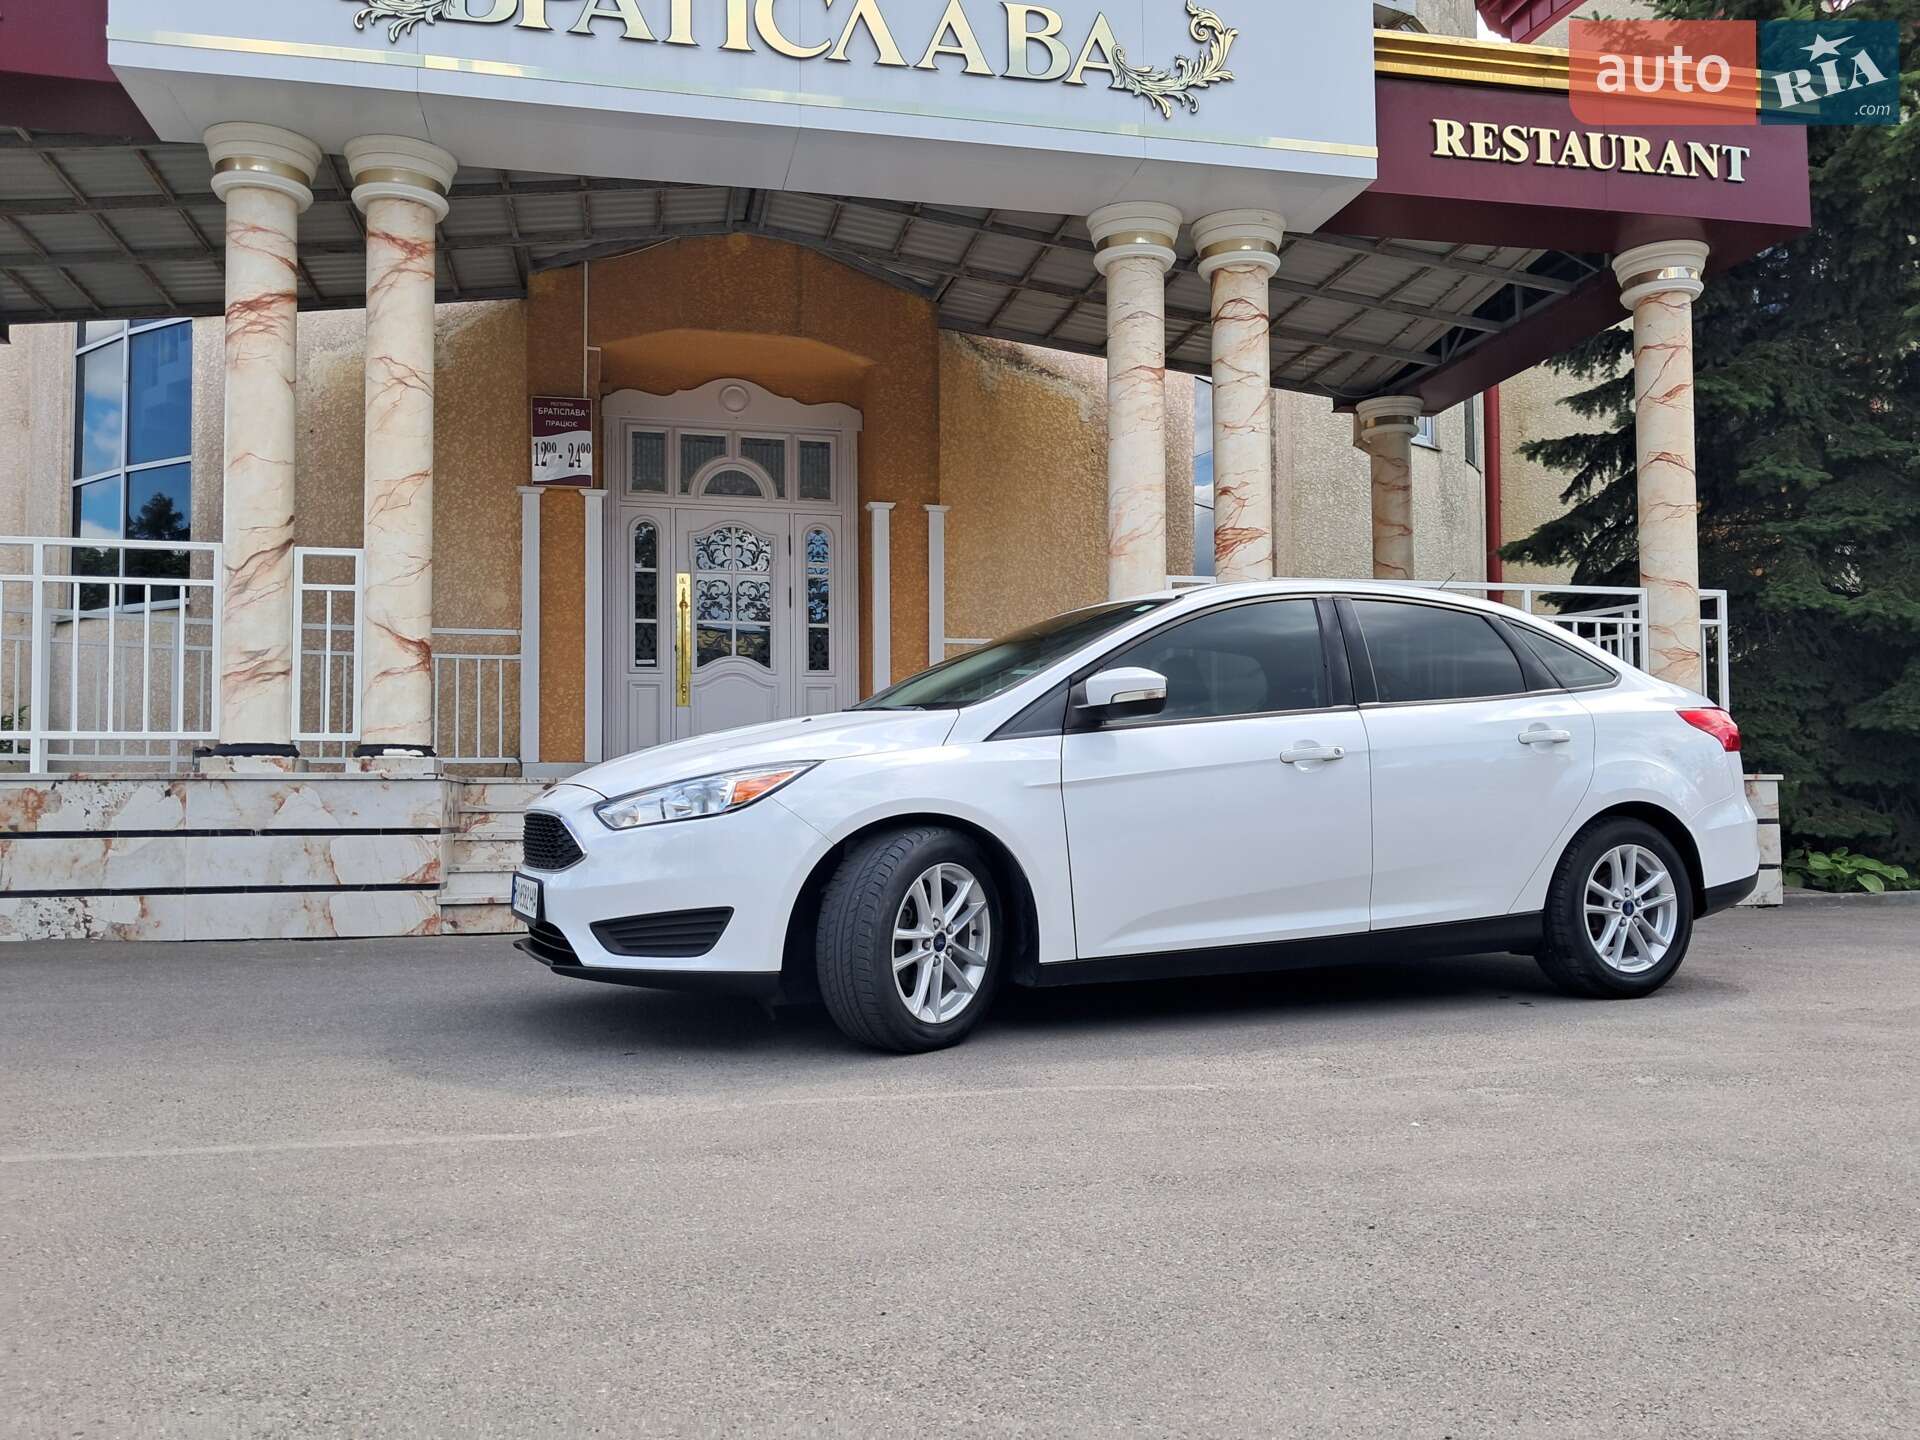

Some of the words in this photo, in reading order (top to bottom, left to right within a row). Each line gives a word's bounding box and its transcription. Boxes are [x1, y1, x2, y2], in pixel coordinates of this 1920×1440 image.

[443, 0, 1124, 89] ІСЛАВА
[1432, 118, 1749, 182] RESTAURANT
[546, 420, 578, 428] ПРАЦЮЄ
